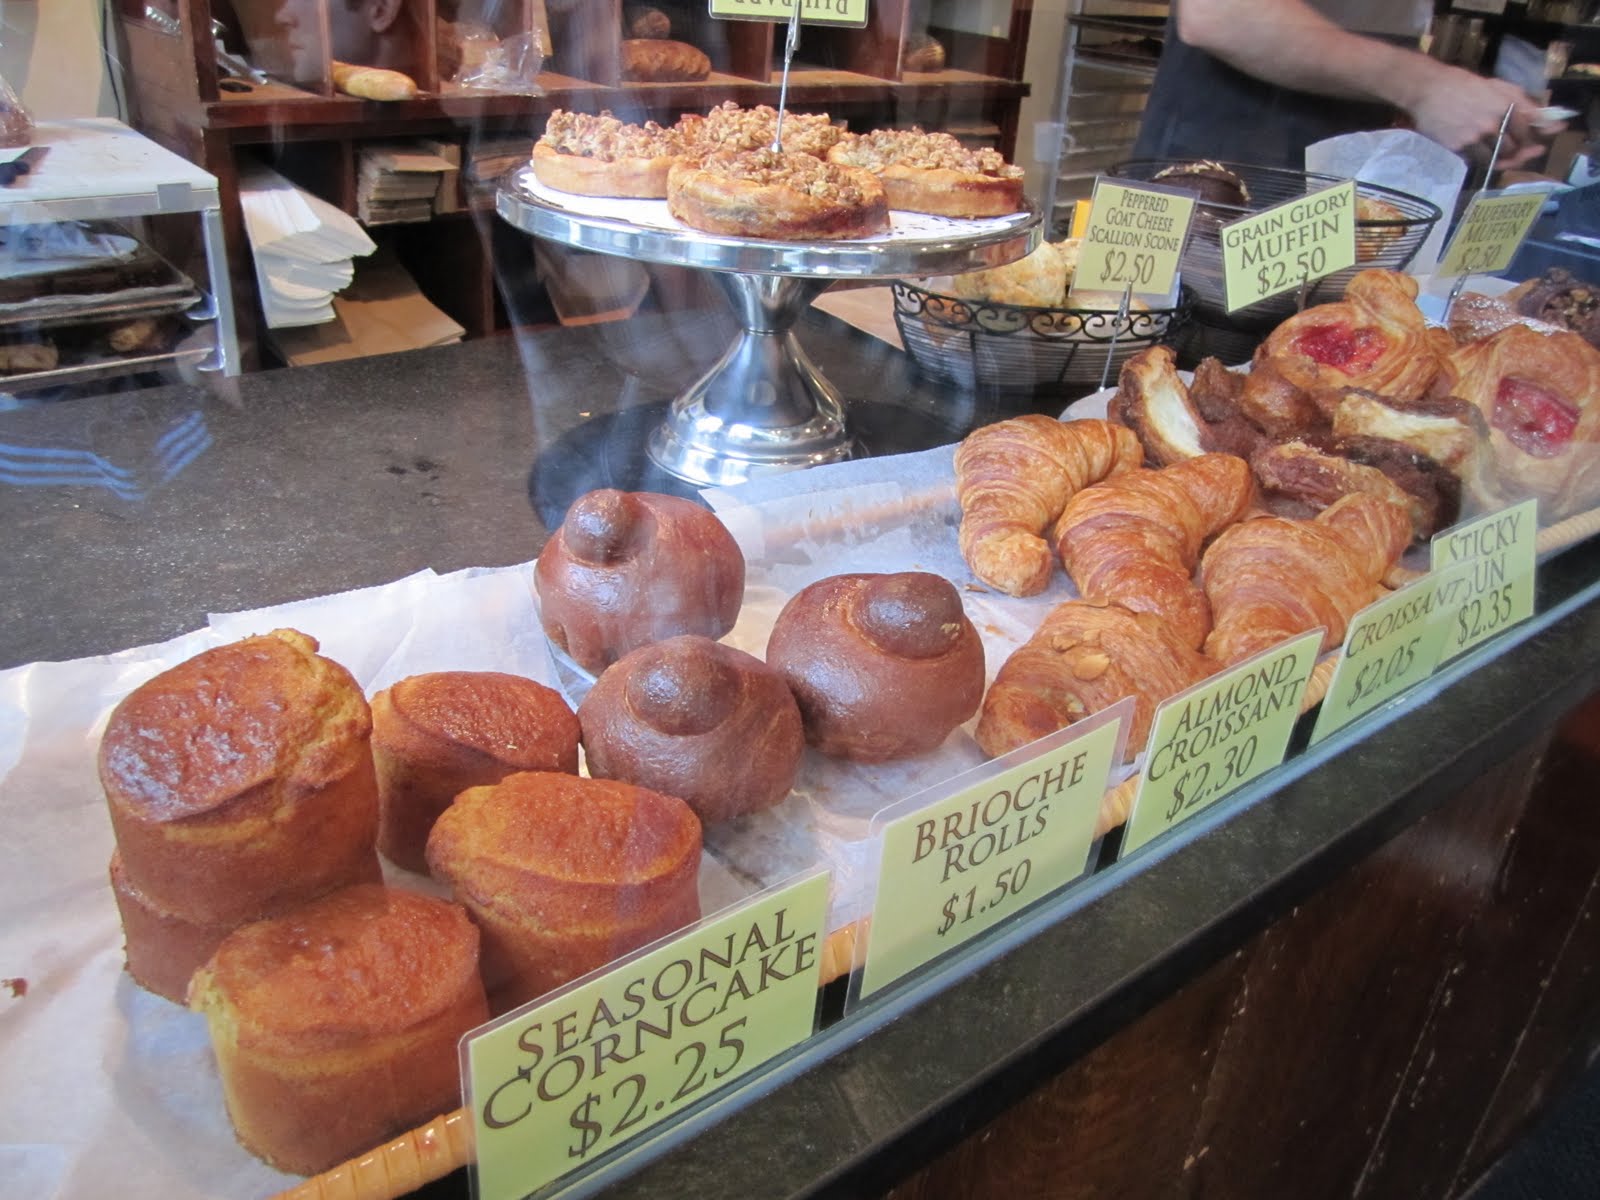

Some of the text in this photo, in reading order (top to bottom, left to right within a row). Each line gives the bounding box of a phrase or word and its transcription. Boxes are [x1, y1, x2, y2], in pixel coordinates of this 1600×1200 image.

[1106, 207, 1174, 233] GOAT CHEESE
[1120, 189, 1169, 213] PEPPERED
[1226, 191, 1351, 248] GRAIN GLORY
[1462, 221, 1524, 244] MUFFIN
[1089, 225, 1179, 252] SCALLION SCONE
[1100, 248, 1155, 285] $2.50
[1241, 213, 1340, 270] MUFFIN
[1257, 246, 1326, 295] $2.50
[1449, 511, 1522, 560] STICKY
[1346, 577, 1465, 658] CROISSANT
[1457, 583, 1513, 647] $2.35
[1169, 653, 1297, 743] ALMOND
[1347, 636, 1422, 707] $2.05
[1148, 676, 1306, 782] CROISSANT
[911, 751, 1088, 864] BRIOCHE
[1166, 735, 1258, 822] $2.30
[940, 804, 1050, 883] ROLLS
[937, 858, 1032, 937] $1.50
[517, 908, 796, 1077] SEASONAL
[483, 932, 817, 1130] CORNCAKE
[568, 1016, 747, 1159] $2.25
